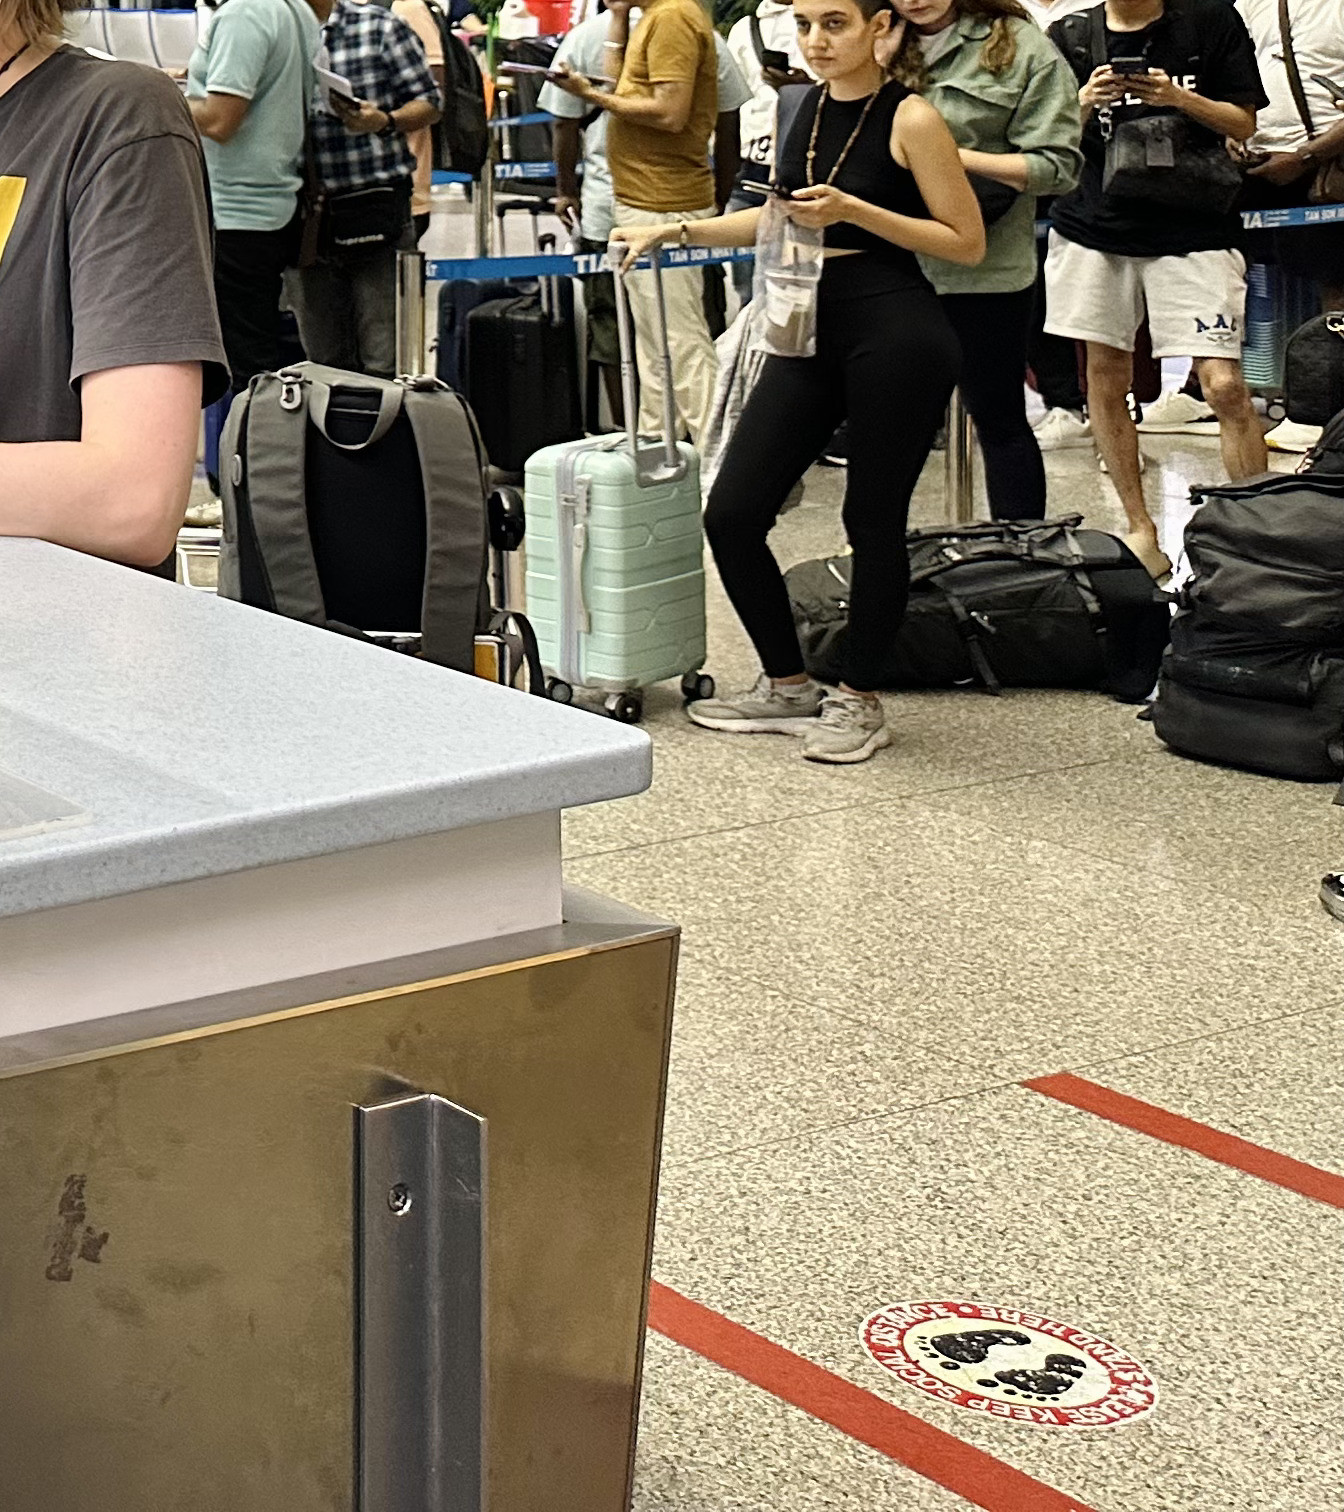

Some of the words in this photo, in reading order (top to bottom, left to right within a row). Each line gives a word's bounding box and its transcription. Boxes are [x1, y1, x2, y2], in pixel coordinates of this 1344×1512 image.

[494, 163, 524, 179] TIA
[573, 253, 613, 275] TIA
[979, 1305, 1069, 1337] HERE
[877, 1347, 962, 1400] SOCIAL
[968, 1397, 1059, 1423] KEEP
